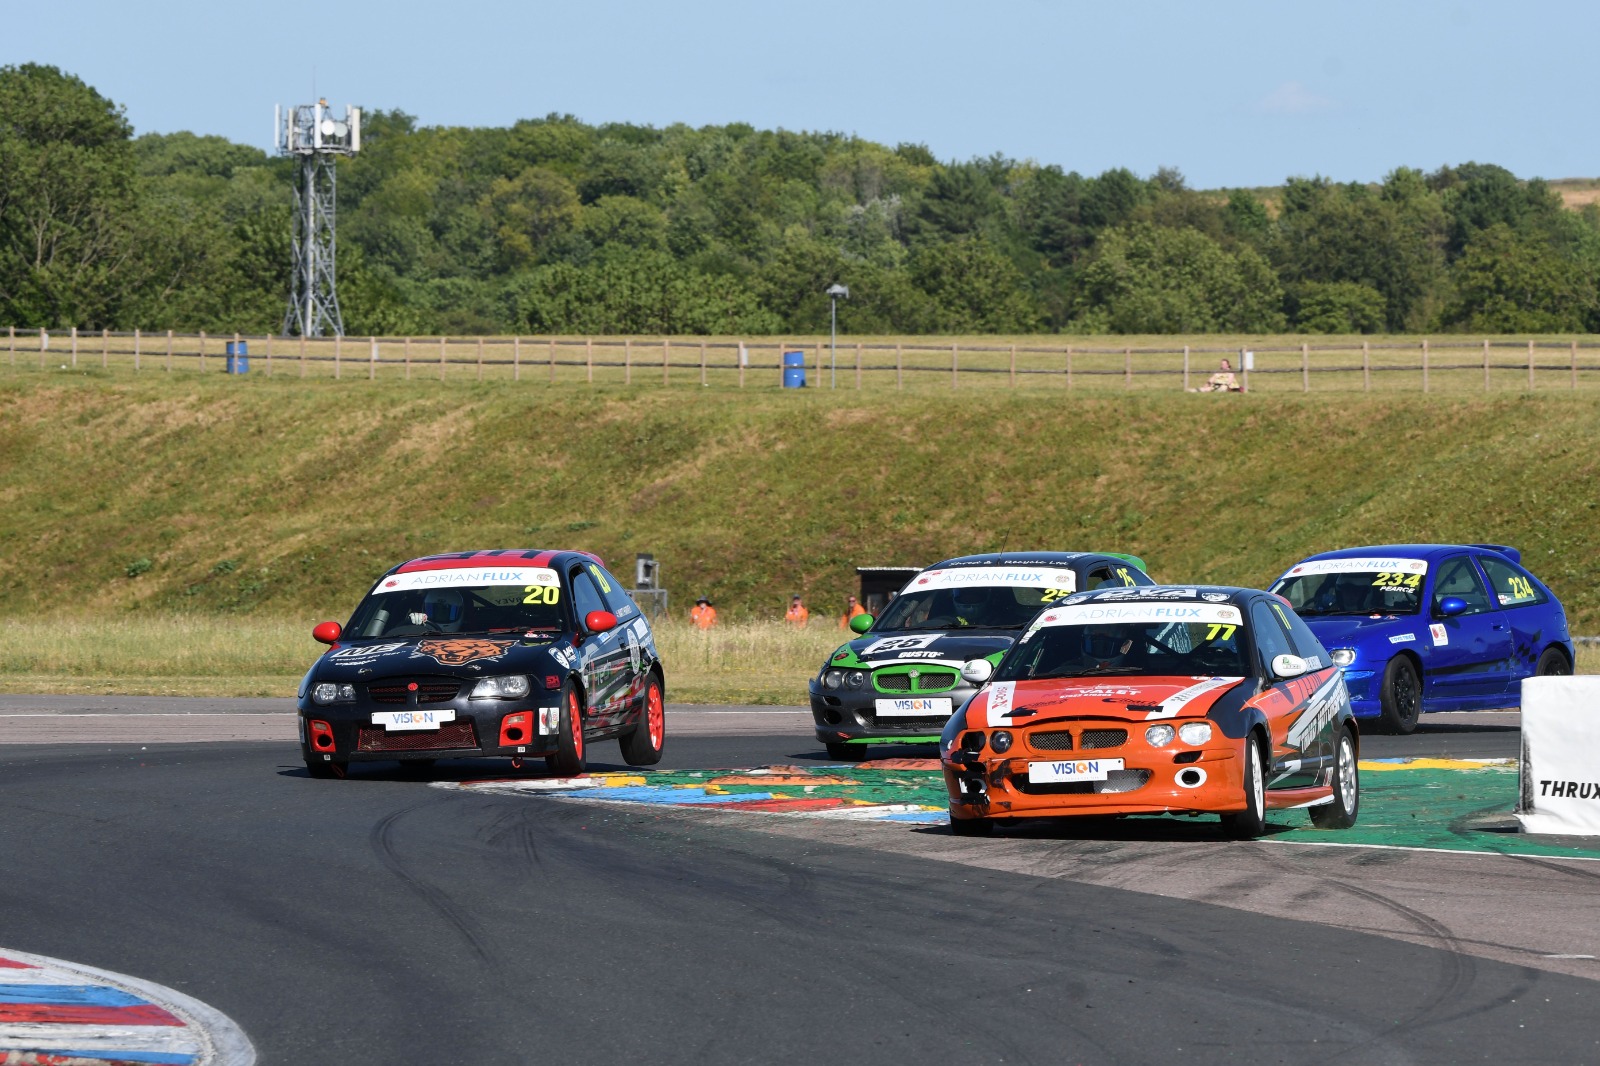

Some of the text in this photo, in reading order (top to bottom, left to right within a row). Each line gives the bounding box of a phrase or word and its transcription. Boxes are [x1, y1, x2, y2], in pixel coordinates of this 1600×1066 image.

[589, 564, 612, 594] 20
[1372, 572, 1421, 588] 234
[1508, 576, 1535, 599] 234
[522, 585, 560, 605] 20
[1204, 623, 1238, 641] 77
[894, 700, 932, 710] VISION
[392, 711, 434, 724] VISION
[1052, 761, 1099, 775] VISION
[1540, 780, 1600, 799] THRUX
